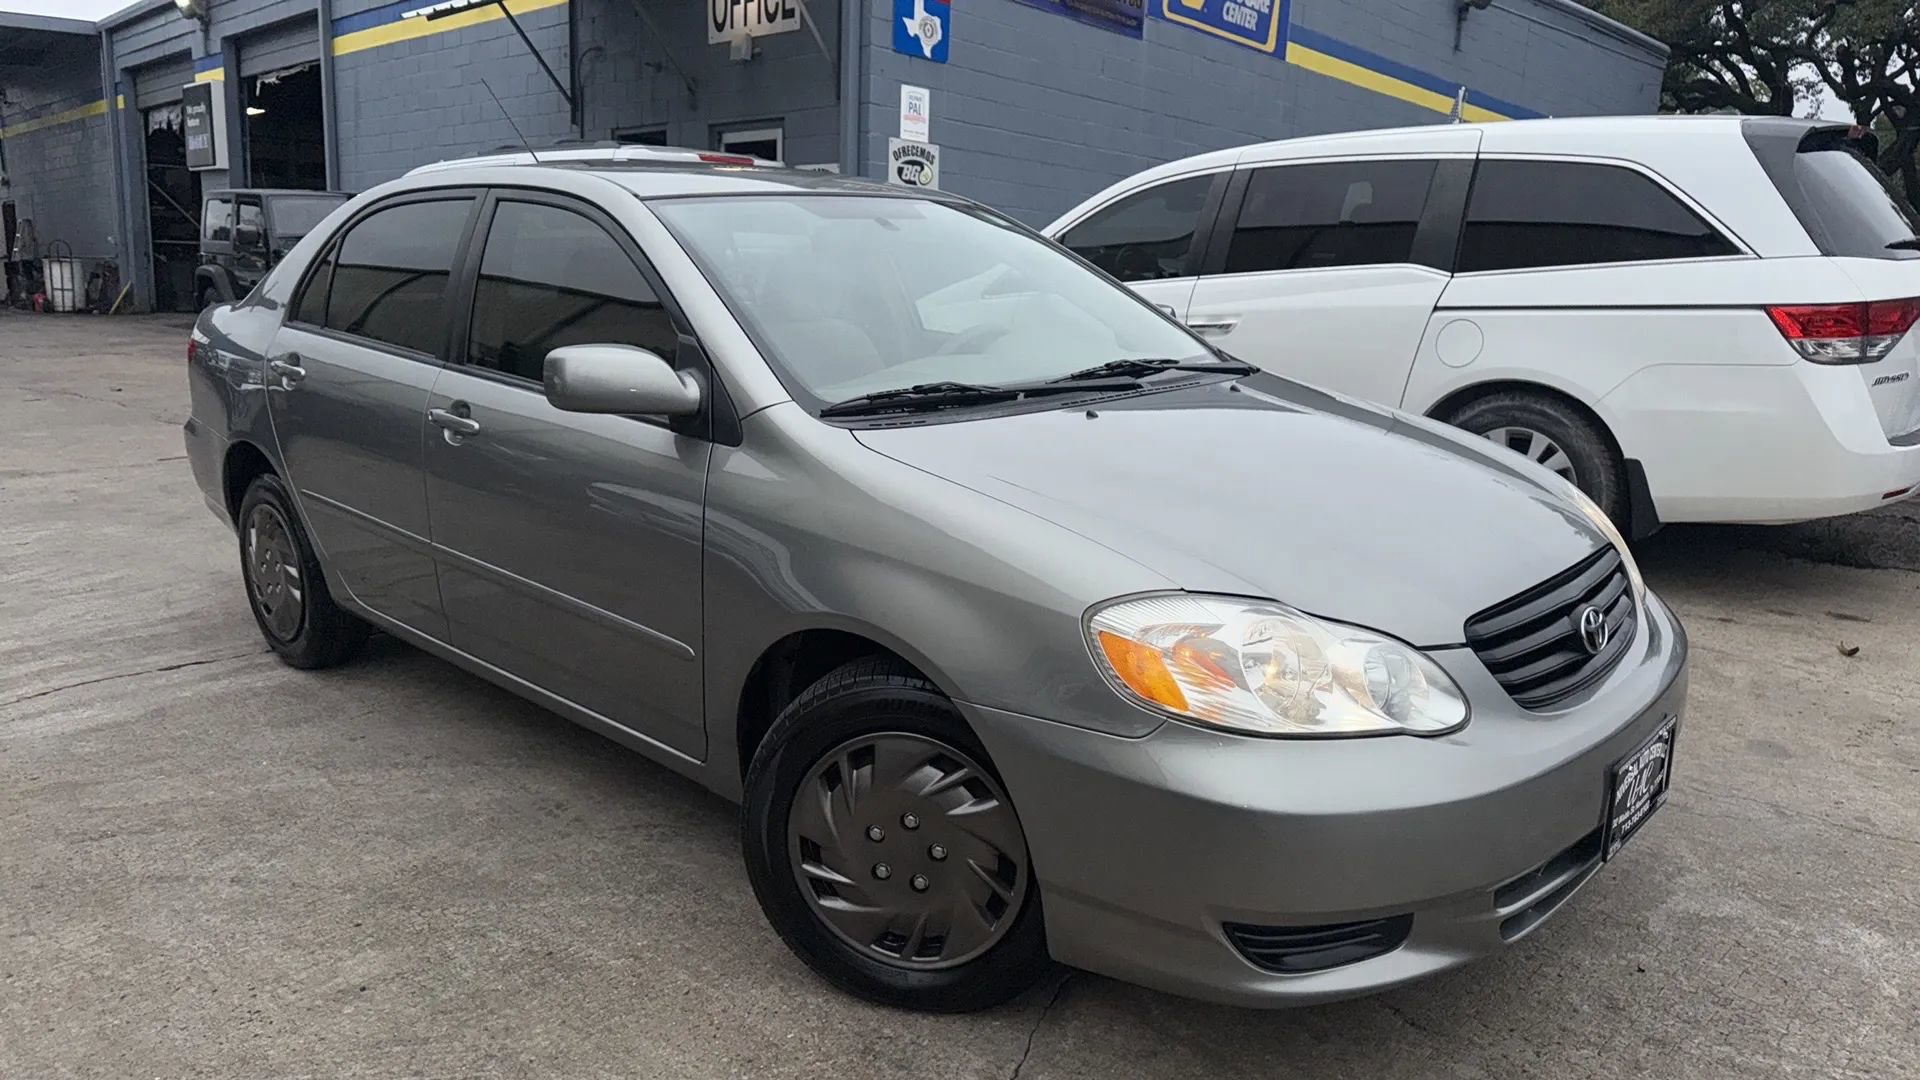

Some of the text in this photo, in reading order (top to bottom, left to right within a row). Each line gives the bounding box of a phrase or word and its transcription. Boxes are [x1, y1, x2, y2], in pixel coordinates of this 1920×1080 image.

[1222, 1, 1258, 31] CENTER
[908, 102, 923, 116] PAL
[893, 144, 936, 166] OFRECEMOS
[901, 164, 923, 181] BG
